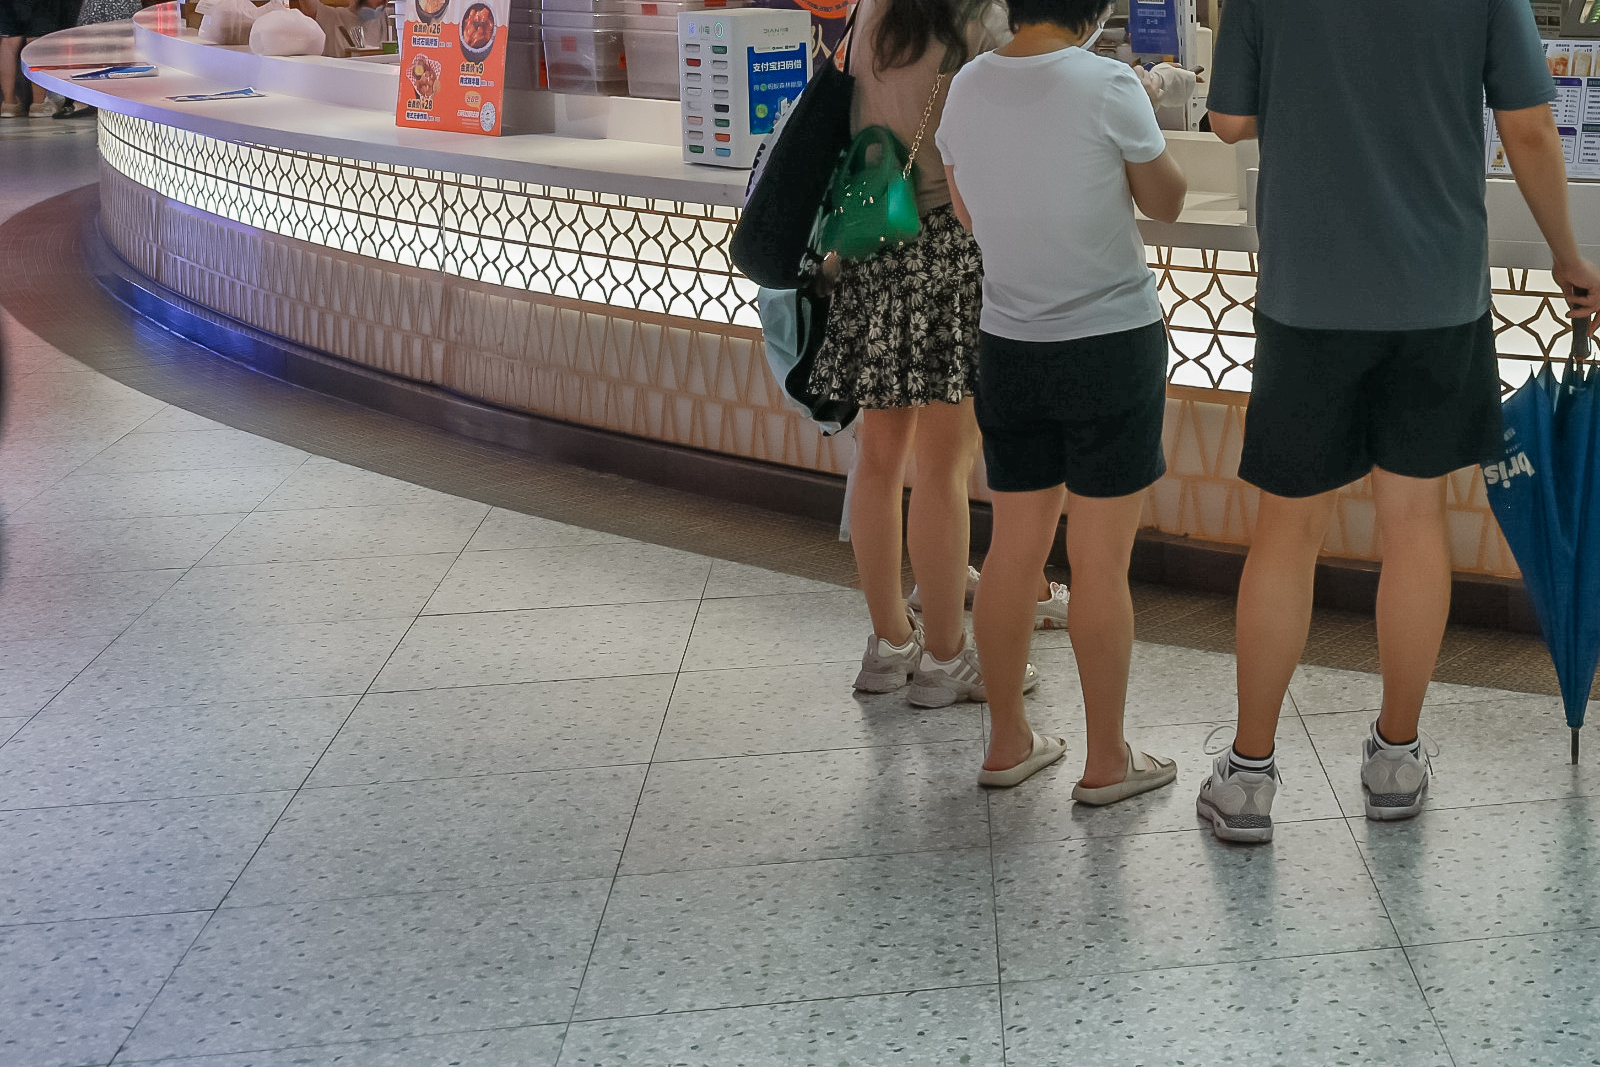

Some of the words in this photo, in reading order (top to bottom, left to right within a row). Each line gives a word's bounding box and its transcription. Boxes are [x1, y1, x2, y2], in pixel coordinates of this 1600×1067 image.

[753, 60, 802, 73] 支付宝扫码借
[1484, 450, 1535, 489] bris
